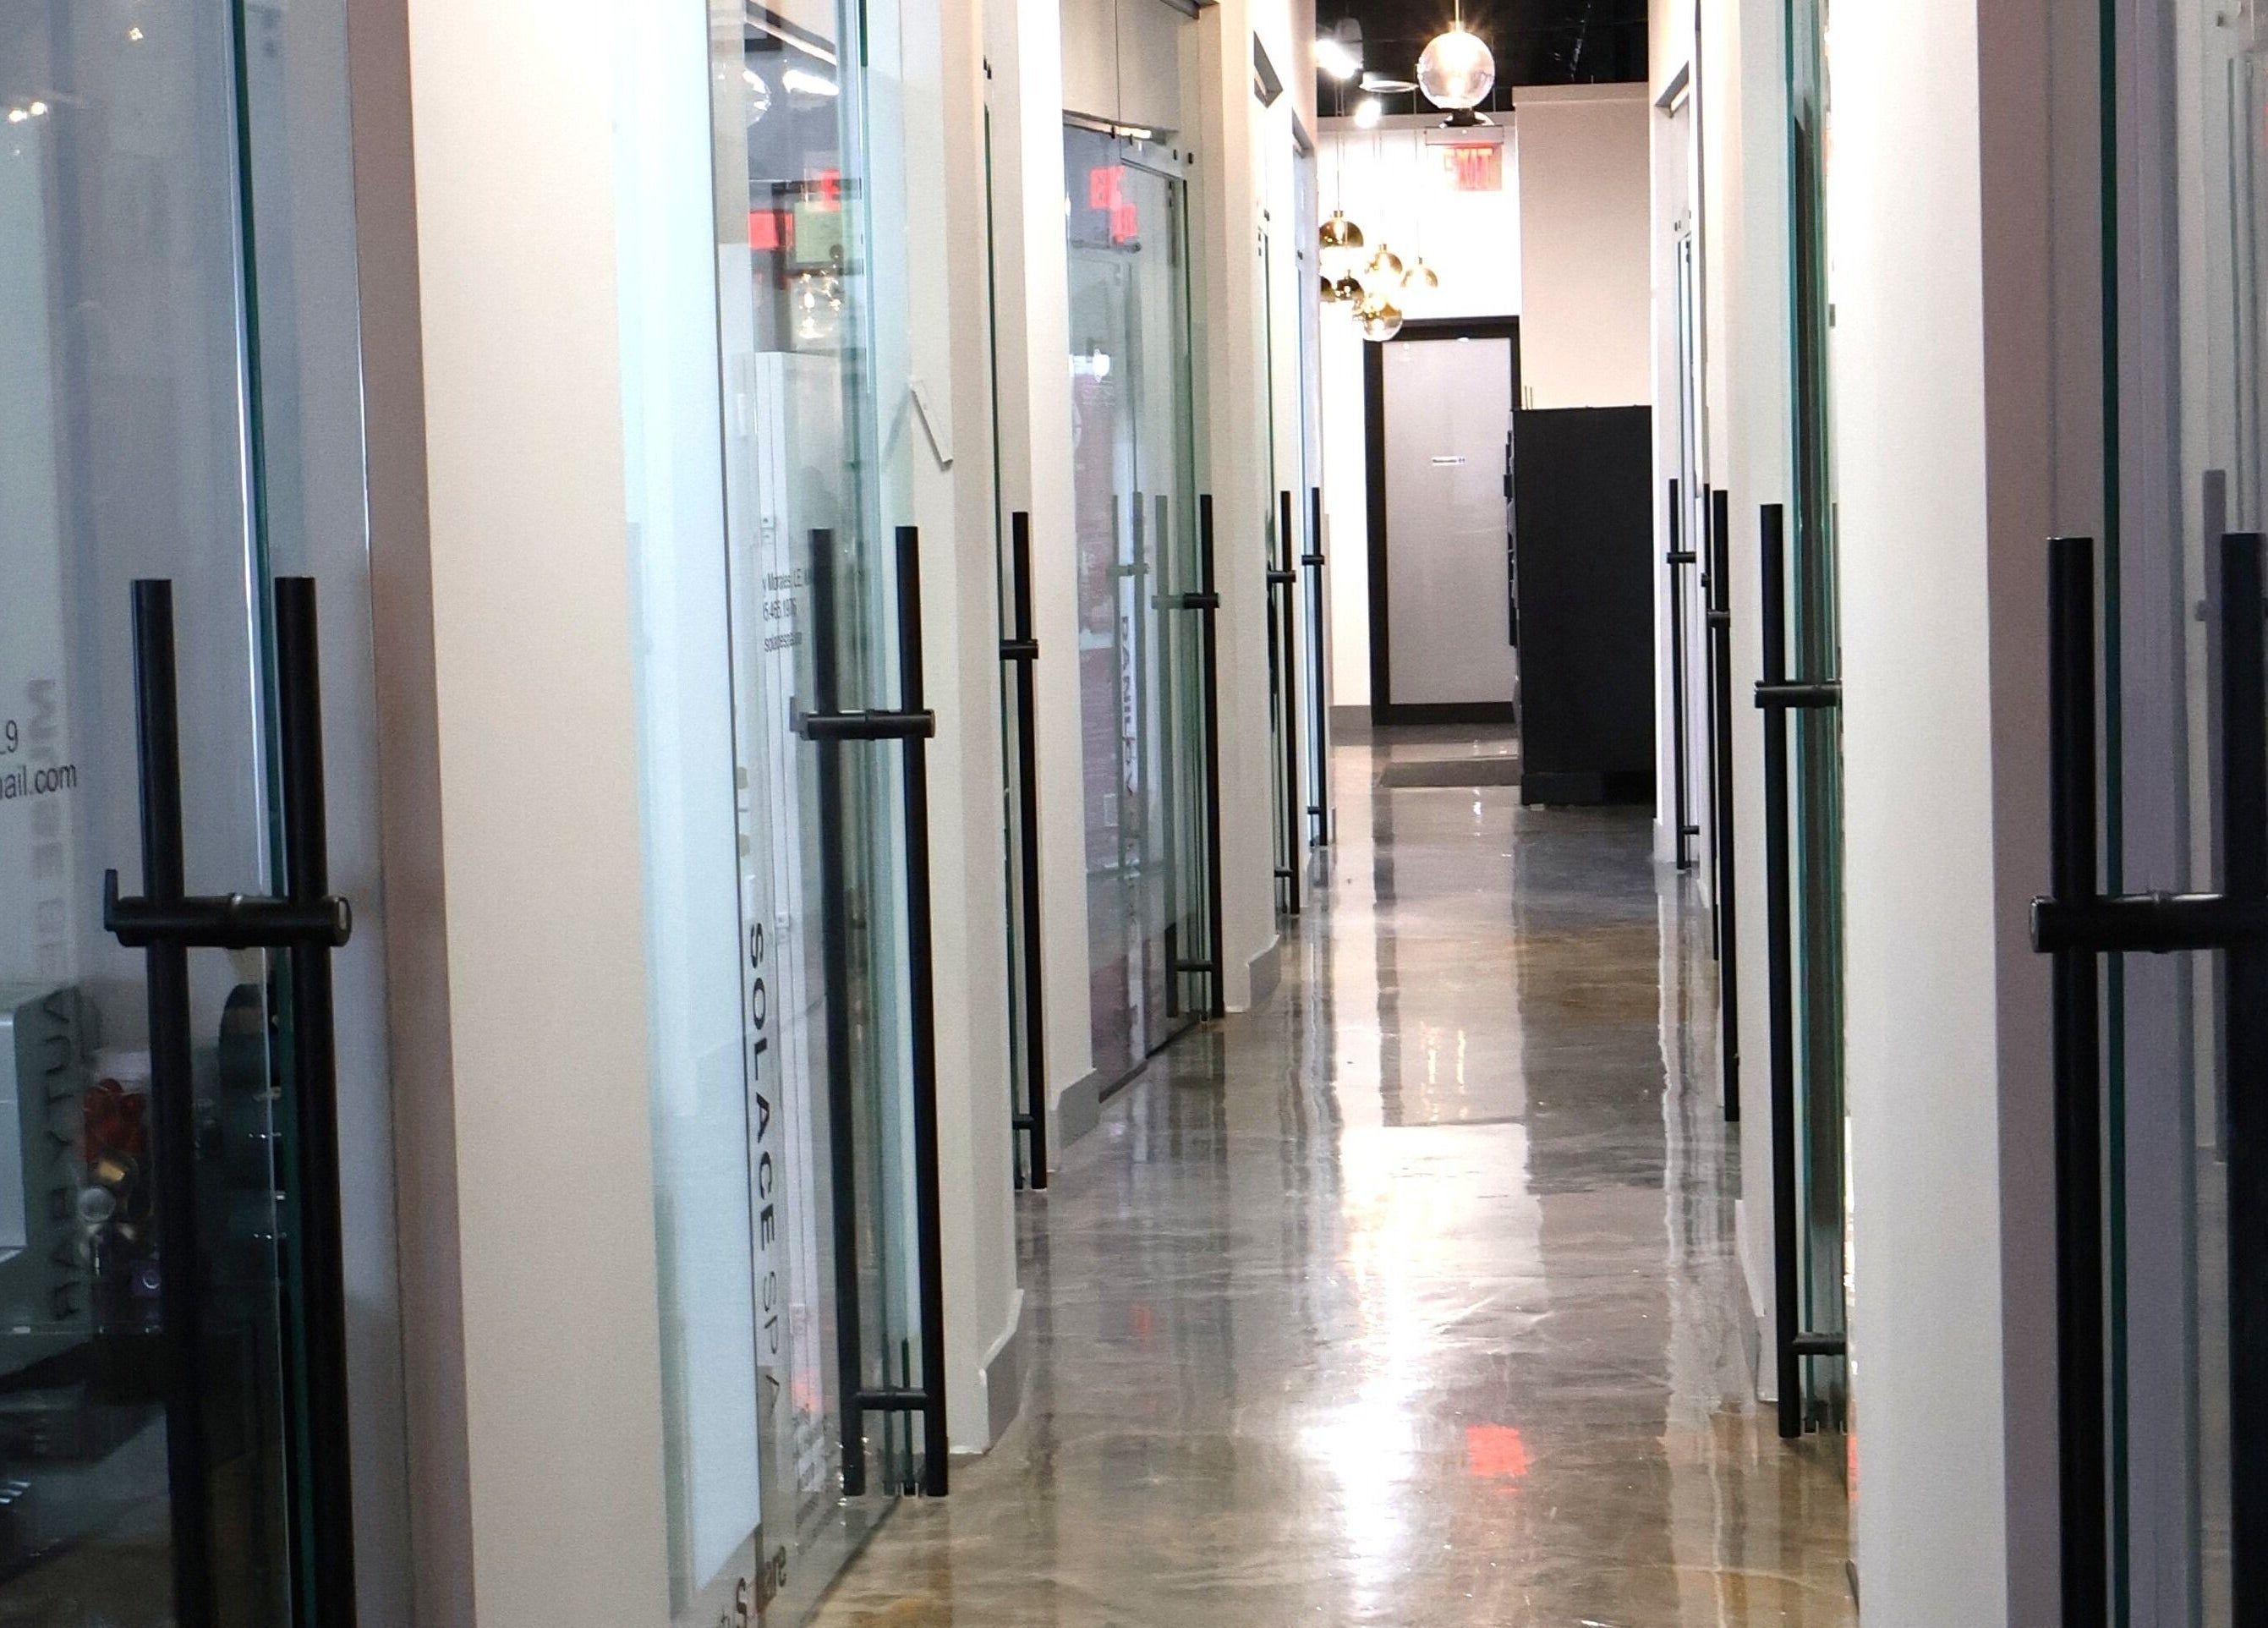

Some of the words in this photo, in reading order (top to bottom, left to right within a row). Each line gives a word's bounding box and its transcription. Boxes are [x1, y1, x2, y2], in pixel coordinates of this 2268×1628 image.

[0, 720, 18, 754] 9
[0, 764, 77, 800] ail.com
[750, 922, 775, 1252] SOLACE
[763, 1270, 781, 1419] SPA
